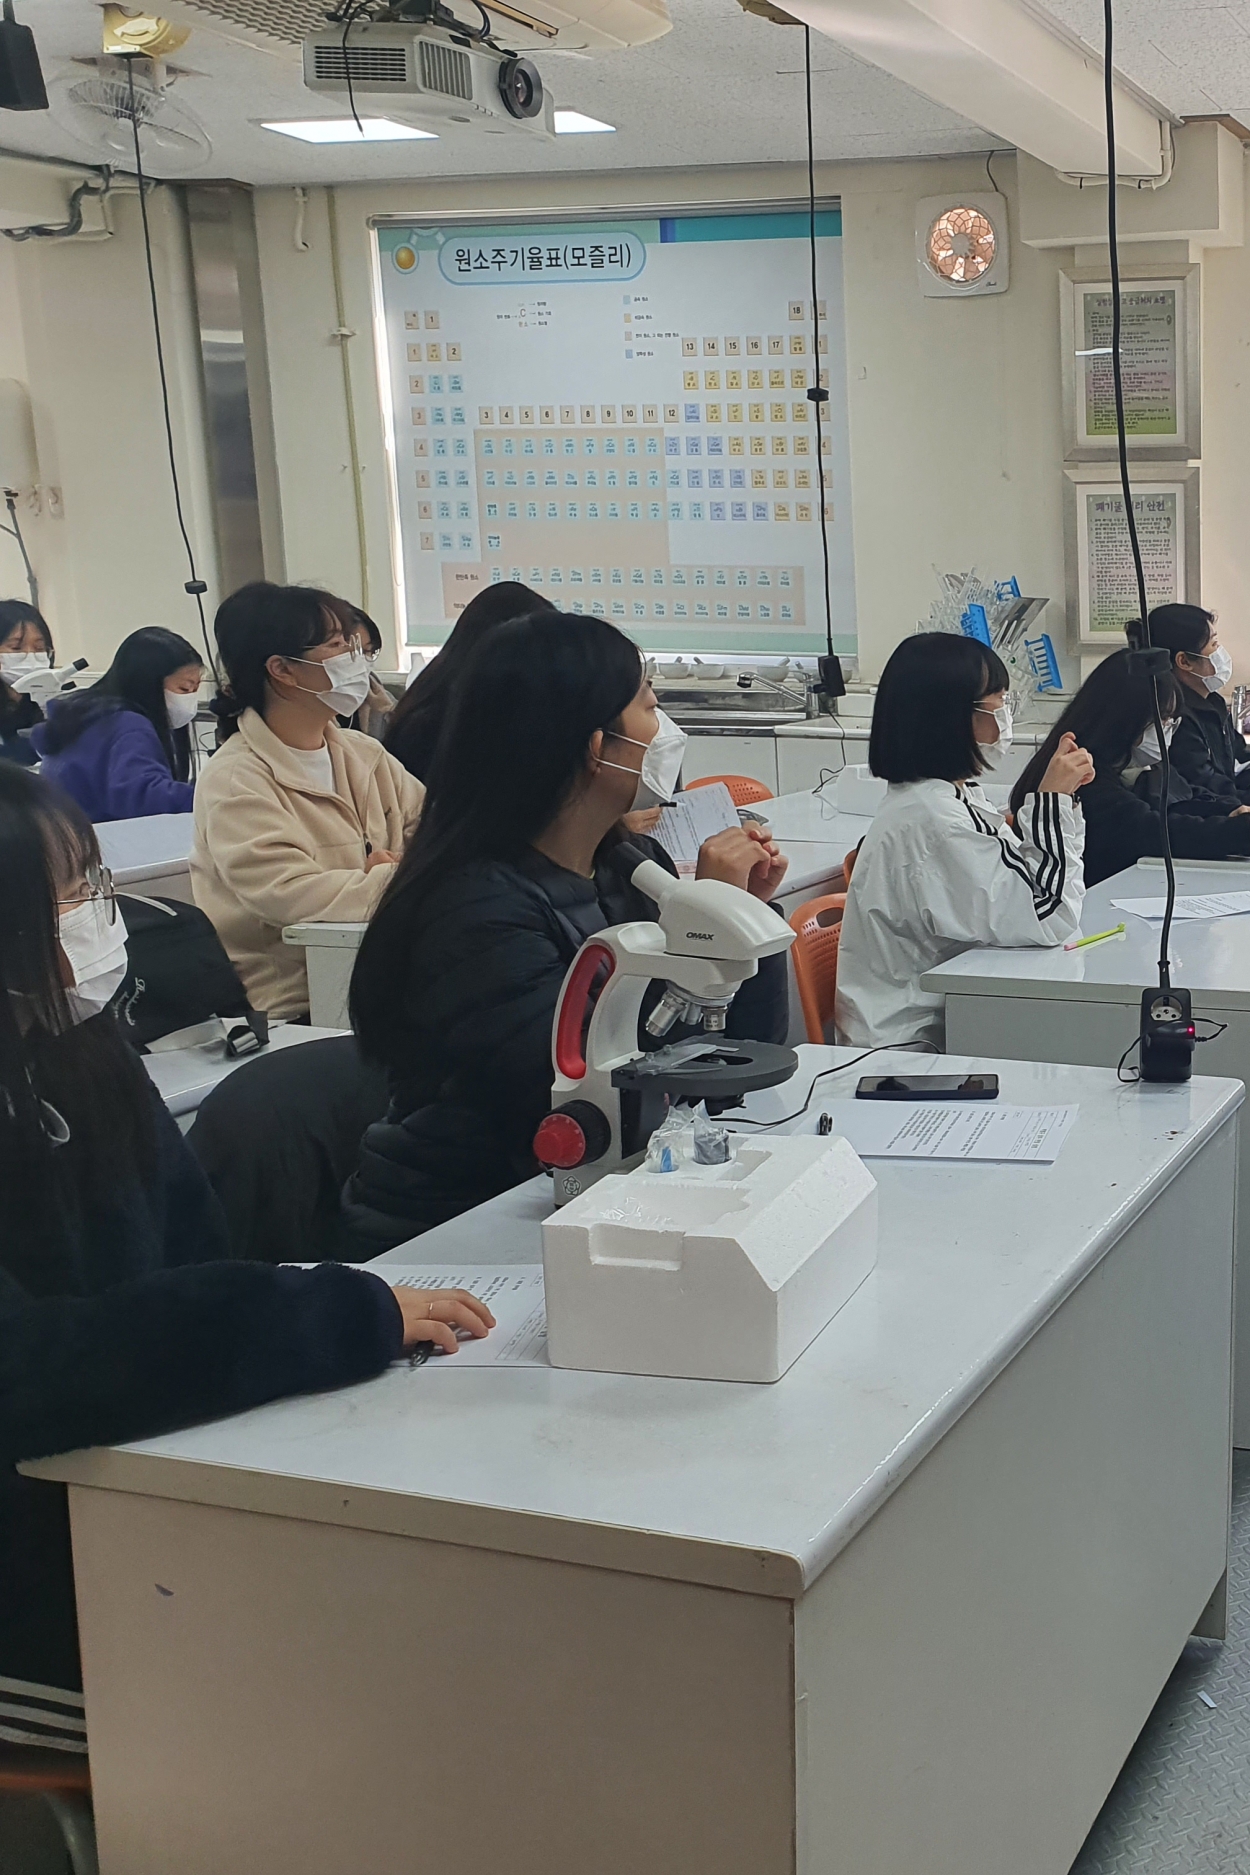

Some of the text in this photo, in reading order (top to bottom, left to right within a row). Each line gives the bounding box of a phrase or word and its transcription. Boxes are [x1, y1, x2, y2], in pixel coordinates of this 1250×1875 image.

[454, 244, 632, 273] 원소주기율표(모즐리)
[1147, 501, 1166, 512] 안전
[686, 932, 714, 940] OMAX
